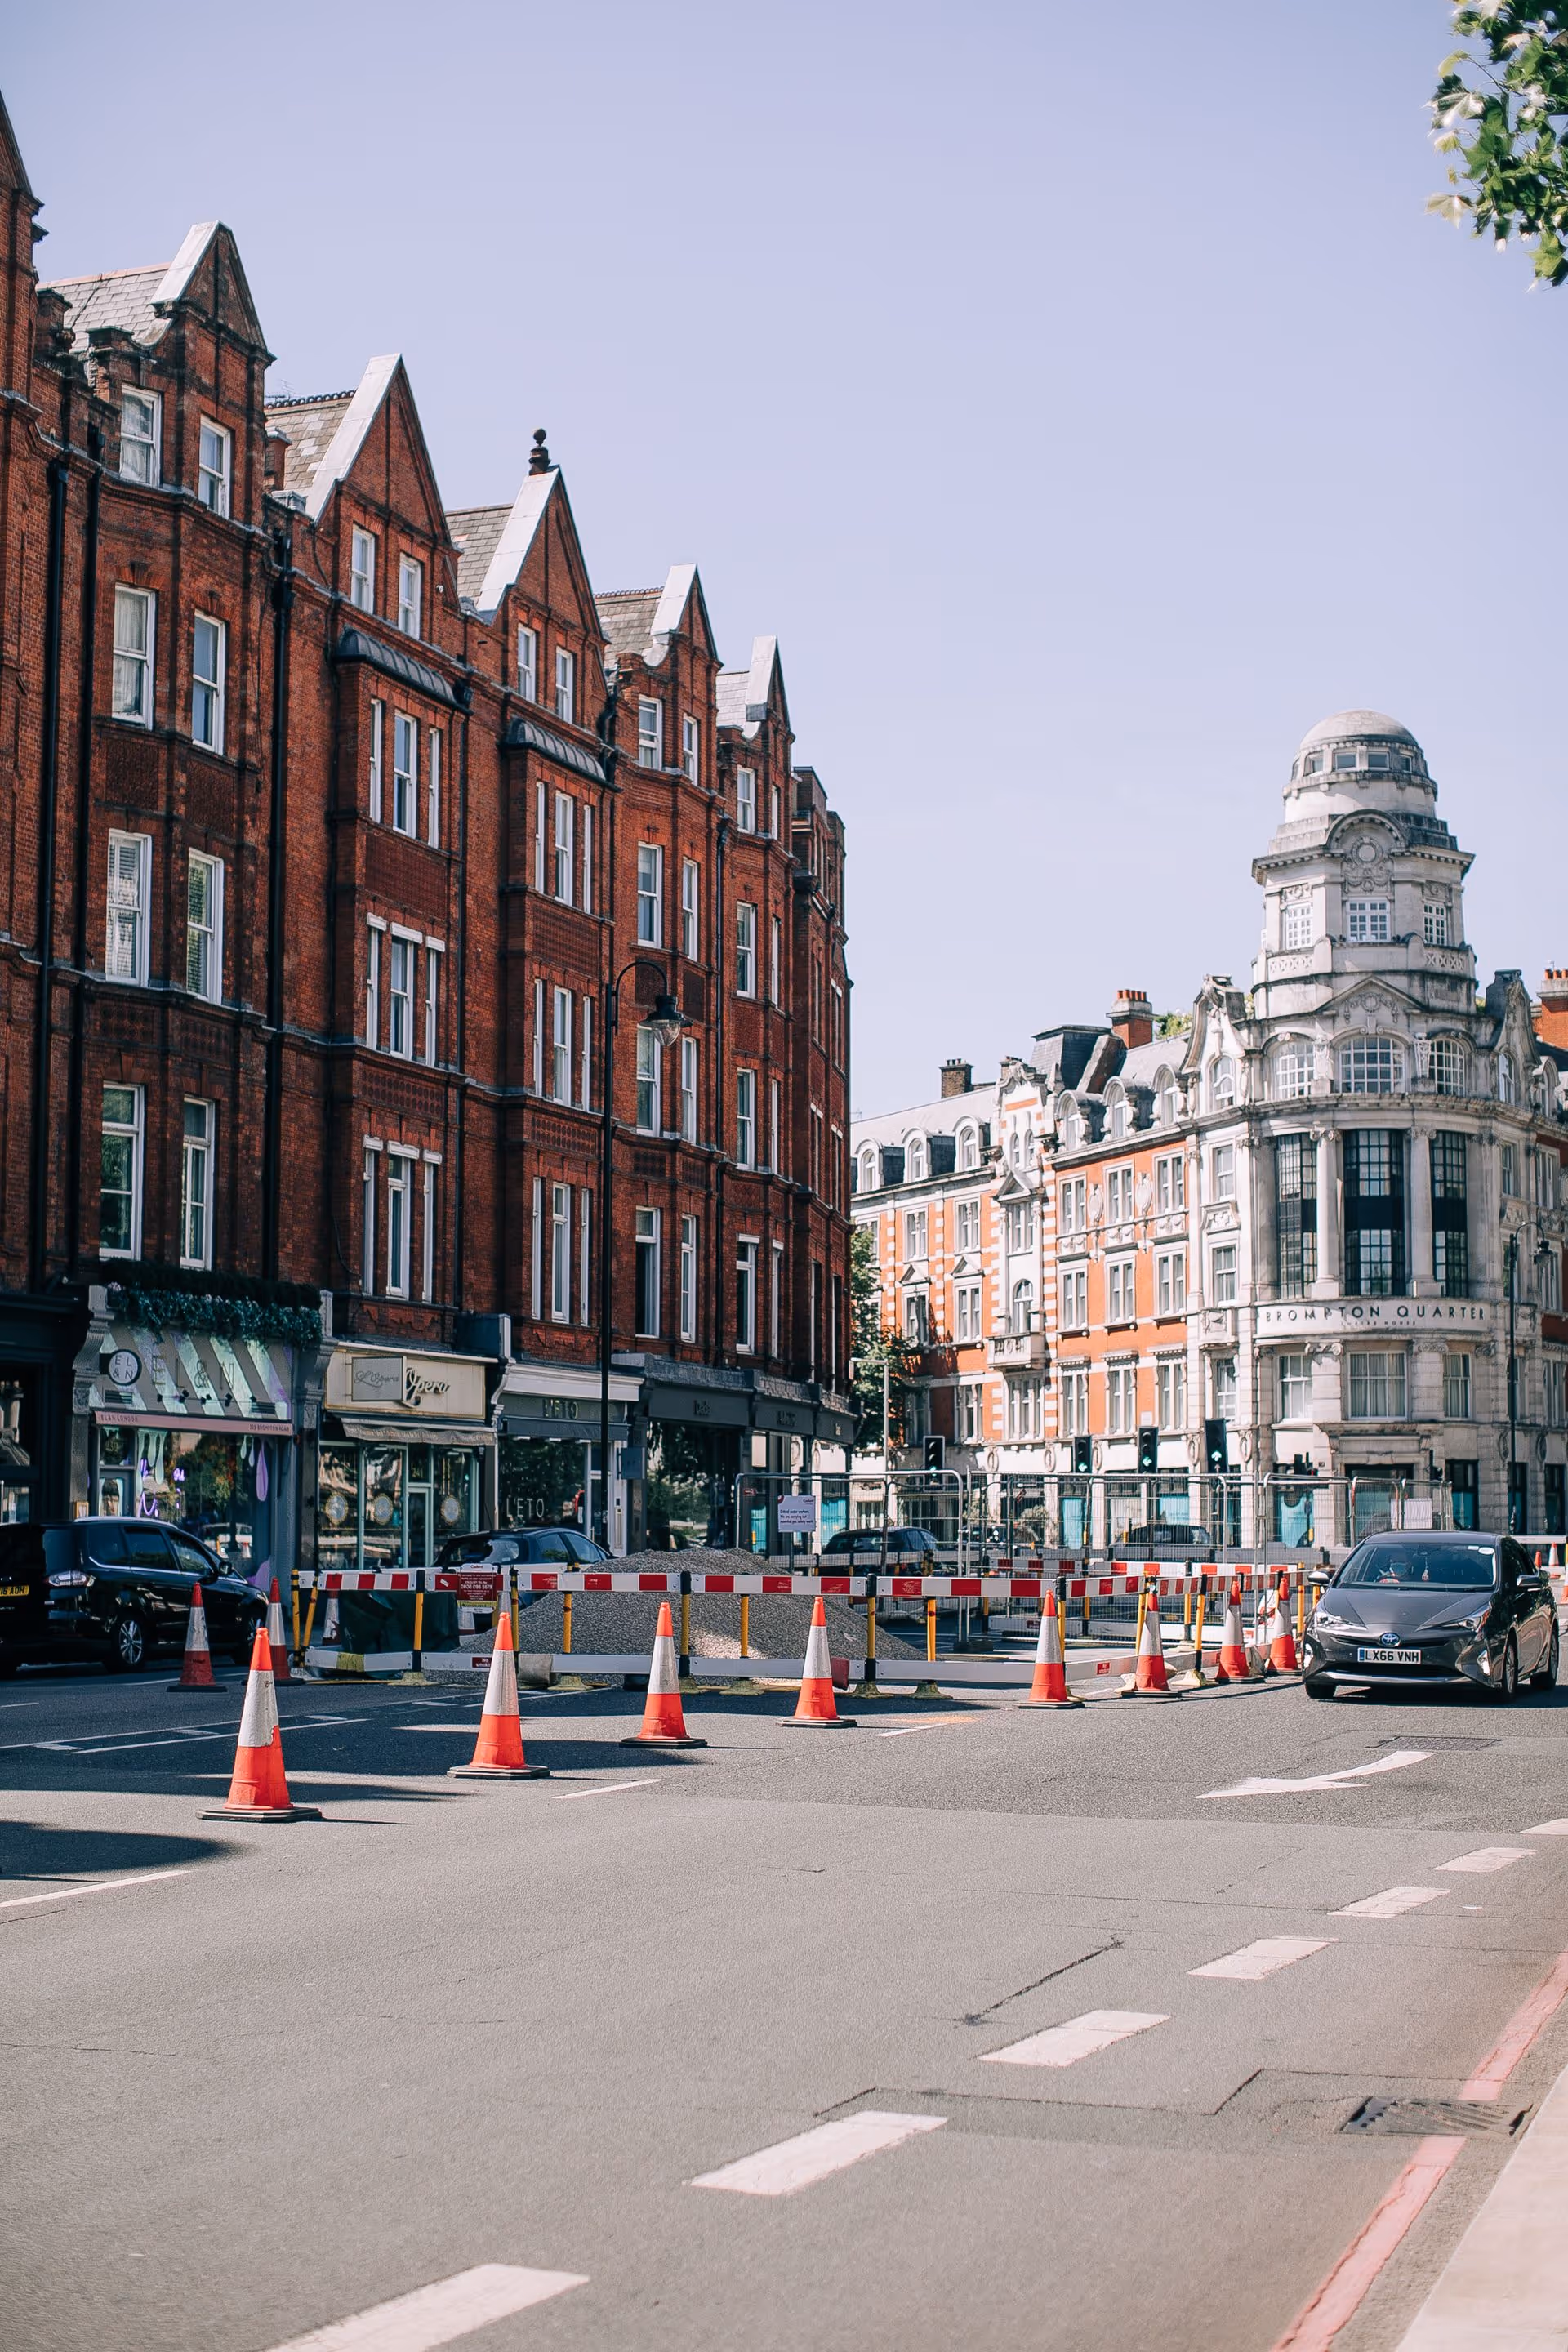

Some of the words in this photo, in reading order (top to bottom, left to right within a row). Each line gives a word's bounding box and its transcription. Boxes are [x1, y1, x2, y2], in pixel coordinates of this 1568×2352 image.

[1266, 1306, 1380, 1322] BROMPTON
[1396, 1306, 1484, 1320] QUARTER
[506, 1498, 545, 1518] L'ETO
[1365, 1650, 1394, 1661] LX66
[1397, 1651, 1419, 1662] VNH
